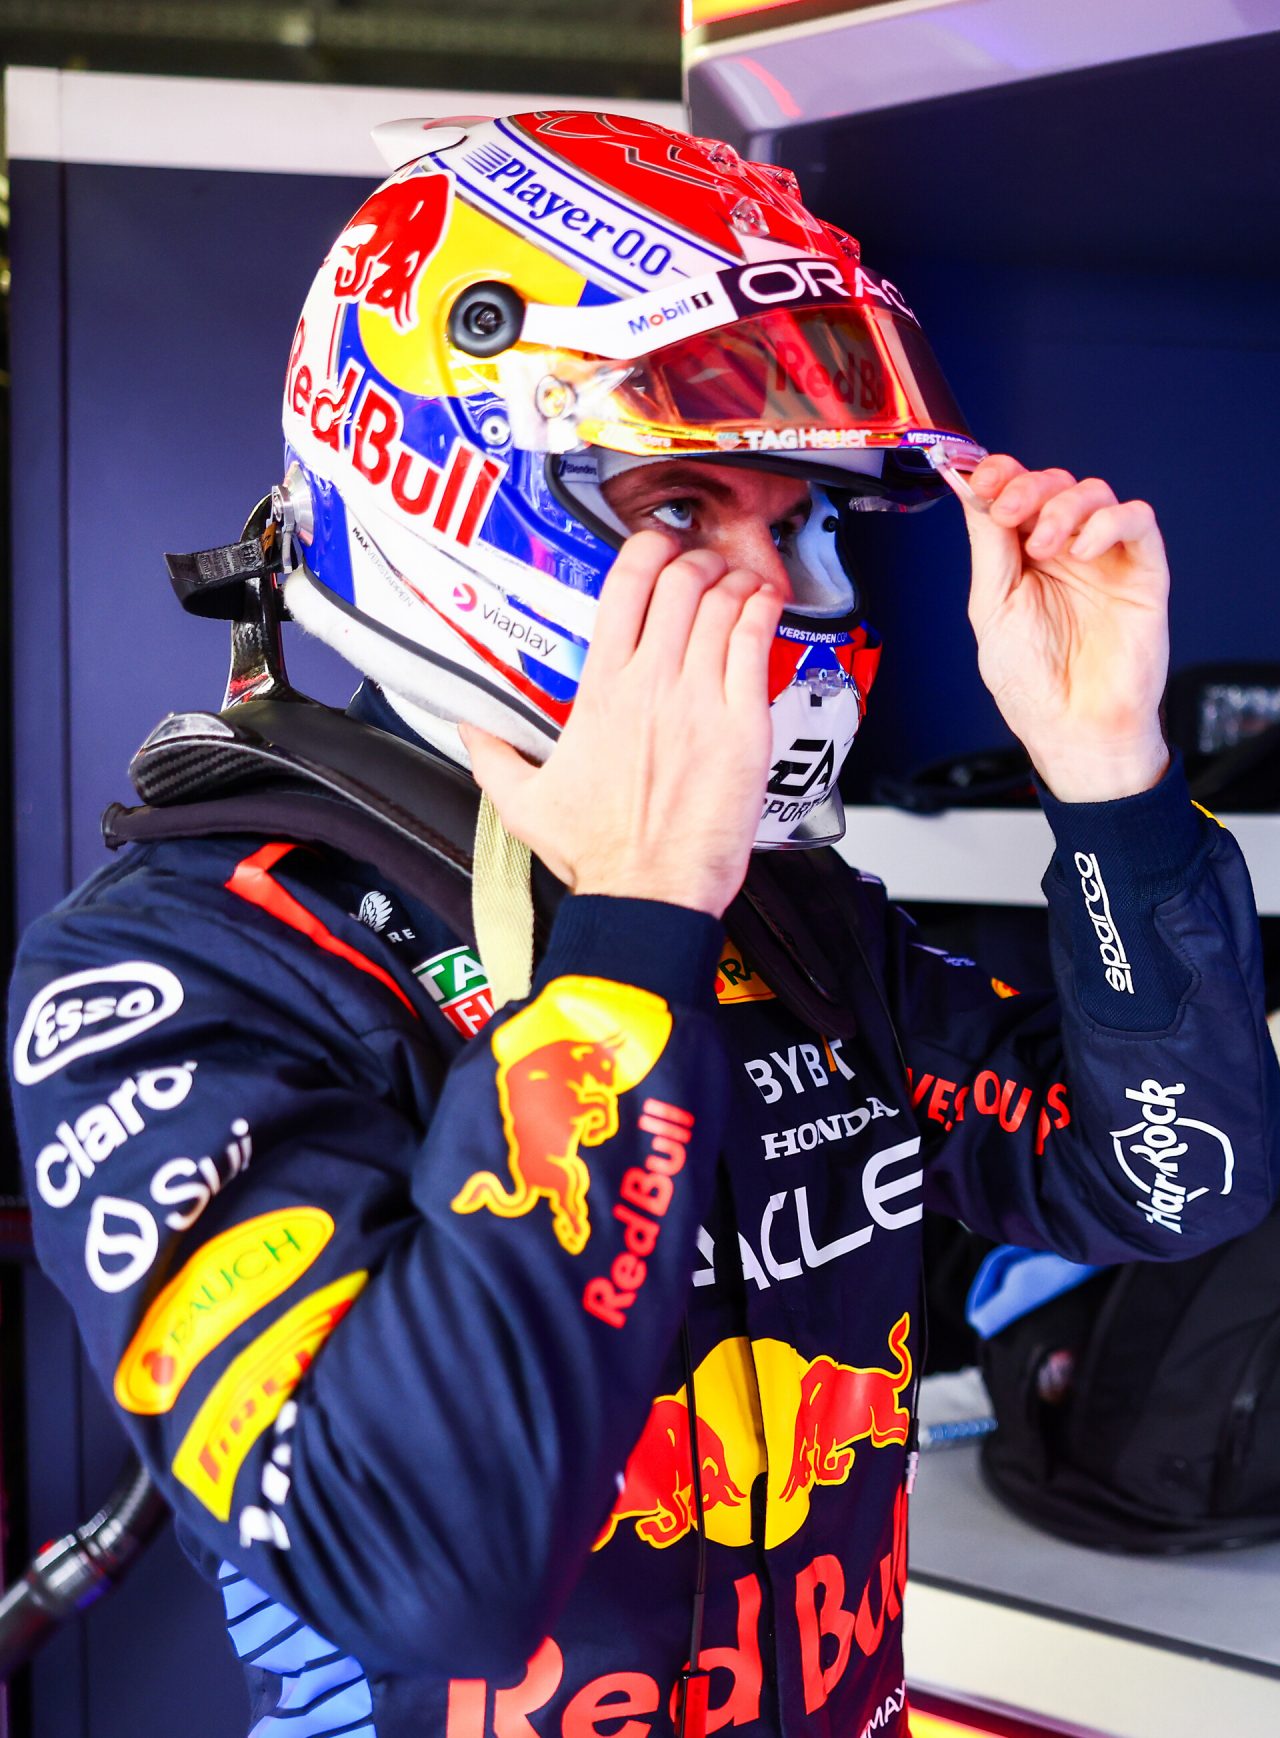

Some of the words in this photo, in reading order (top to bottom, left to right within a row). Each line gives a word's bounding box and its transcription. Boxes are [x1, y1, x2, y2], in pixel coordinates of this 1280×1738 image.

[486, 157, 615, 243] Player
[611, 228, 672, 276] 0.0
[627, 297, 690, 336] Mobil
[693, 291, 713, 310] 1
[285, 318, 358, 453] Red
[352, 388, 500, 548] Bull
[744, 429, 797, 451] TAG
[482, 603, 558, 657] viaplay
[766, 738, 835, 797] EA
[1074, 851, 1135, 994] sparco
[417, 954, 488, 1003] TA
[34, 1061, 198, 1209] Claro
[619, 1097, 696, 1218] Bull
[760, 1096, 900, 1161] HONDA
[1125, 1078, 1189, 1178] Rock
[582, 1203, 661, 1329] Red
[446, 1572, 763, 1738] Red
